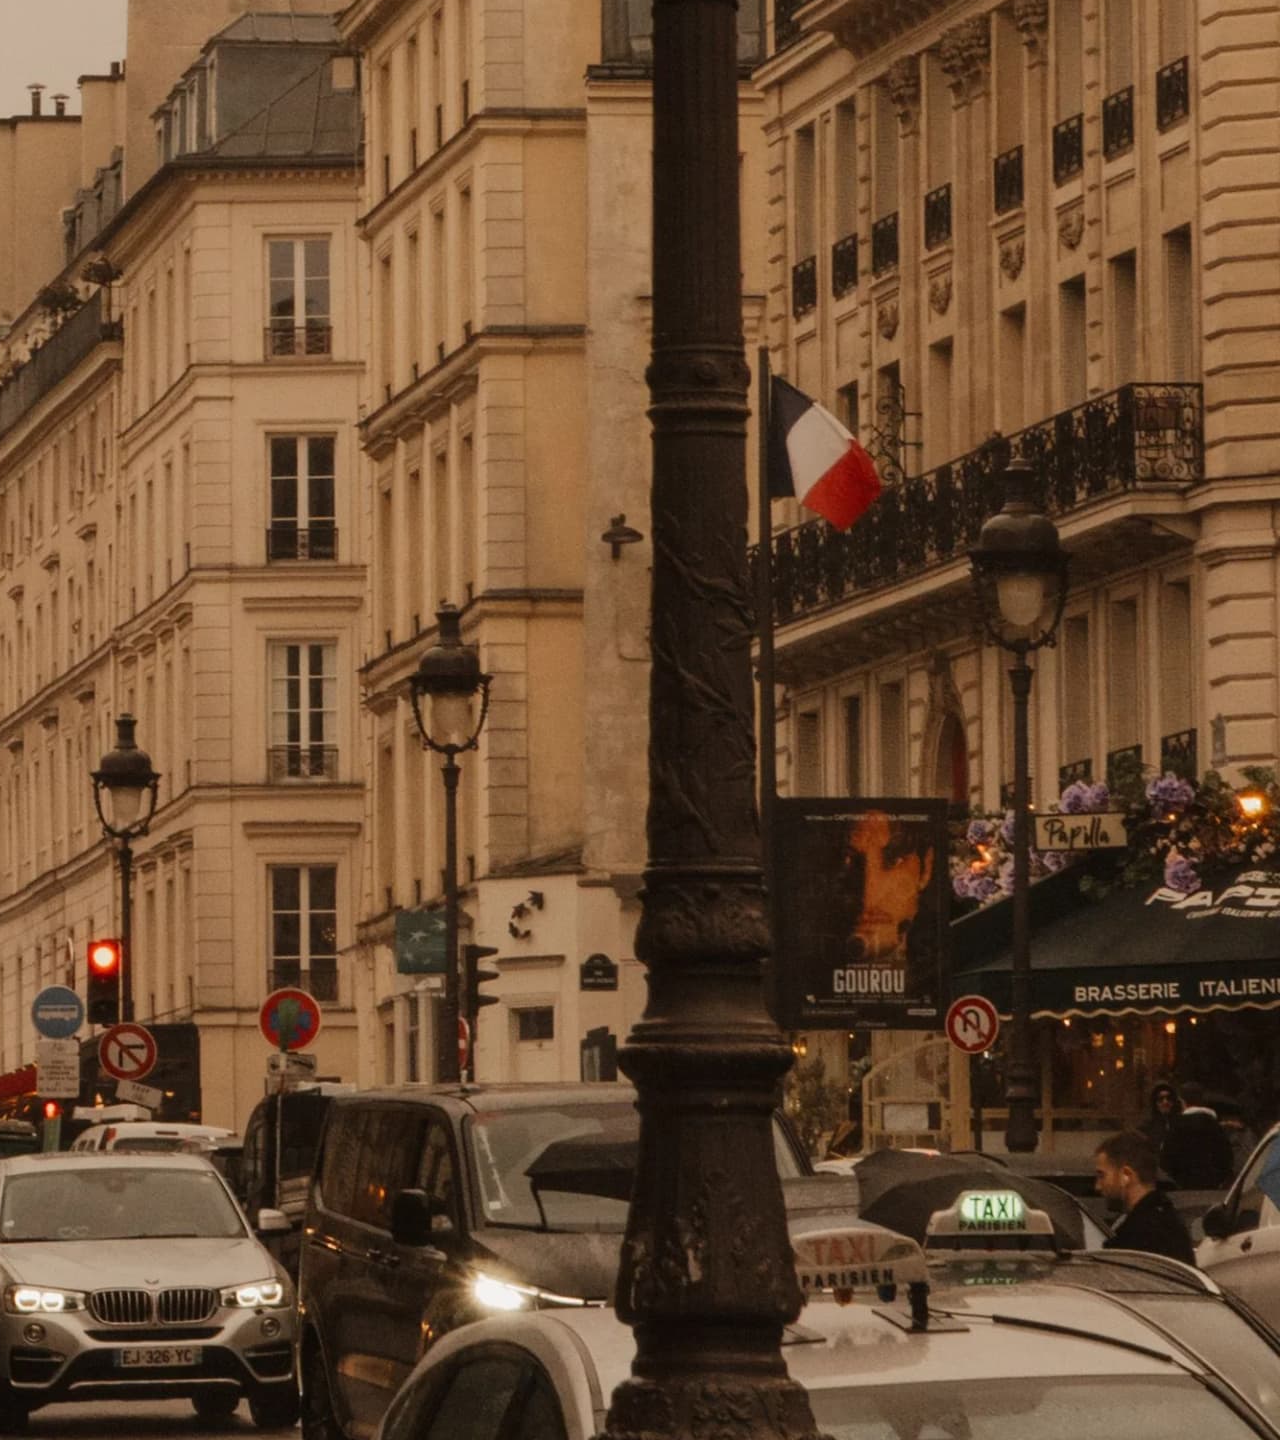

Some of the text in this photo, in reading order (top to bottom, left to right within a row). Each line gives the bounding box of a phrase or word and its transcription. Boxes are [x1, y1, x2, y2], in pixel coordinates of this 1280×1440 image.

[1042, 817, 1110, 849] Papilla
[832, 969, 906, 994] GOUROU
[1074, 982, 1181, 1002] BRASSERIE
[970, 1197, 1018, 1219] TAXI
[958, 1219, 1027, 1231] PARISIEN
[808, 1236, 876, 1266] TAXI
[801, 1268, 894, 1290] PARISIEN
